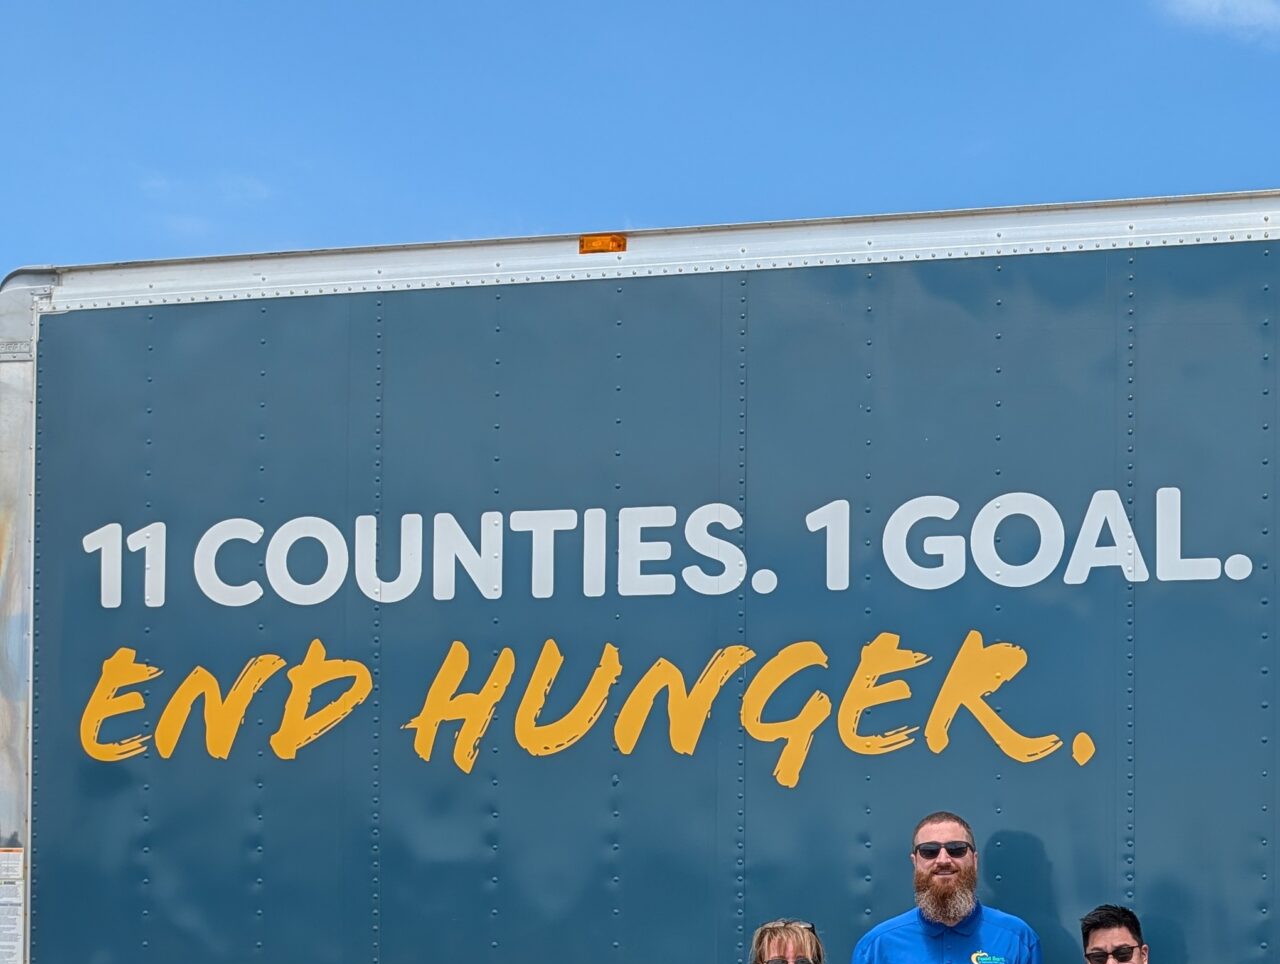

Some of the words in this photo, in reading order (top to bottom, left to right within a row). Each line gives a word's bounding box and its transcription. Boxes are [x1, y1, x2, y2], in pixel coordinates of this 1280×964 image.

[82, 522, 166, 608] 11
[193, 502, 778, 606] COUNTIES.
[805, 499, 849, 591] 1
[882, 486, 1253, 590] GOAL.
[79, 638, 373, 762] END
[400, 630, 1096, 788] HUNGER.
